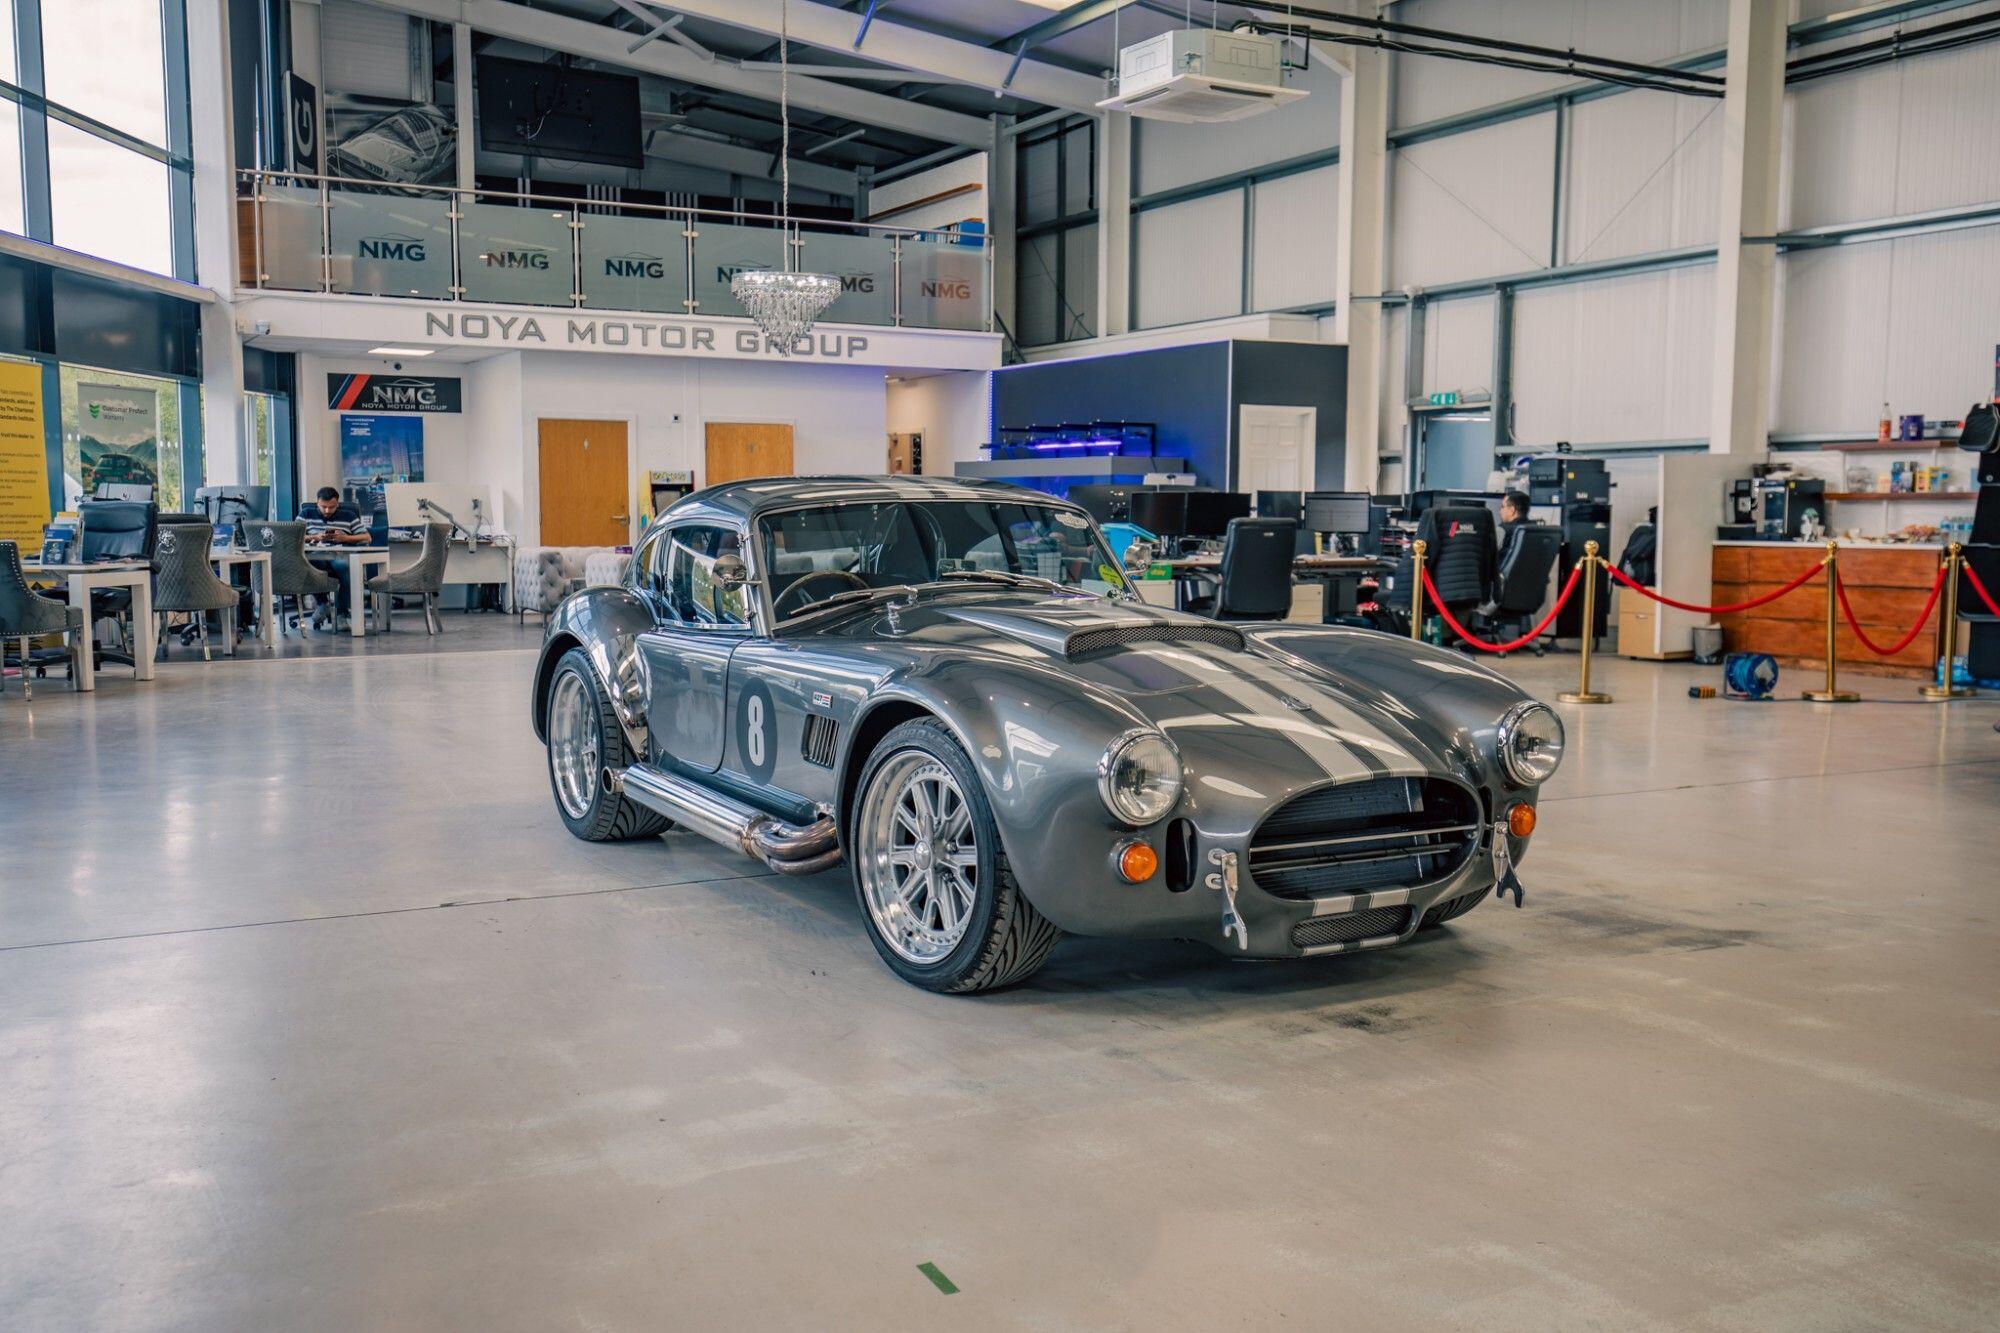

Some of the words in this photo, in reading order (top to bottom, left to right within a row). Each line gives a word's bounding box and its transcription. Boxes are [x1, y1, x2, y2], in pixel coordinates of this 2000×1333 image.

[358, 239, 426, 262] NMG
[486, 251, 550, 270] NMG
[605, 259, 664, 279] NMG
[840, 275, 874, 293] MG
[921, 281, 971, 299] NMG
[426, 311, 546, 342] NOYA
[567, 319, 715, 351] MOTOR
[372, 386, 437, 404] NMG
[747, 694, 765, 767] 8
